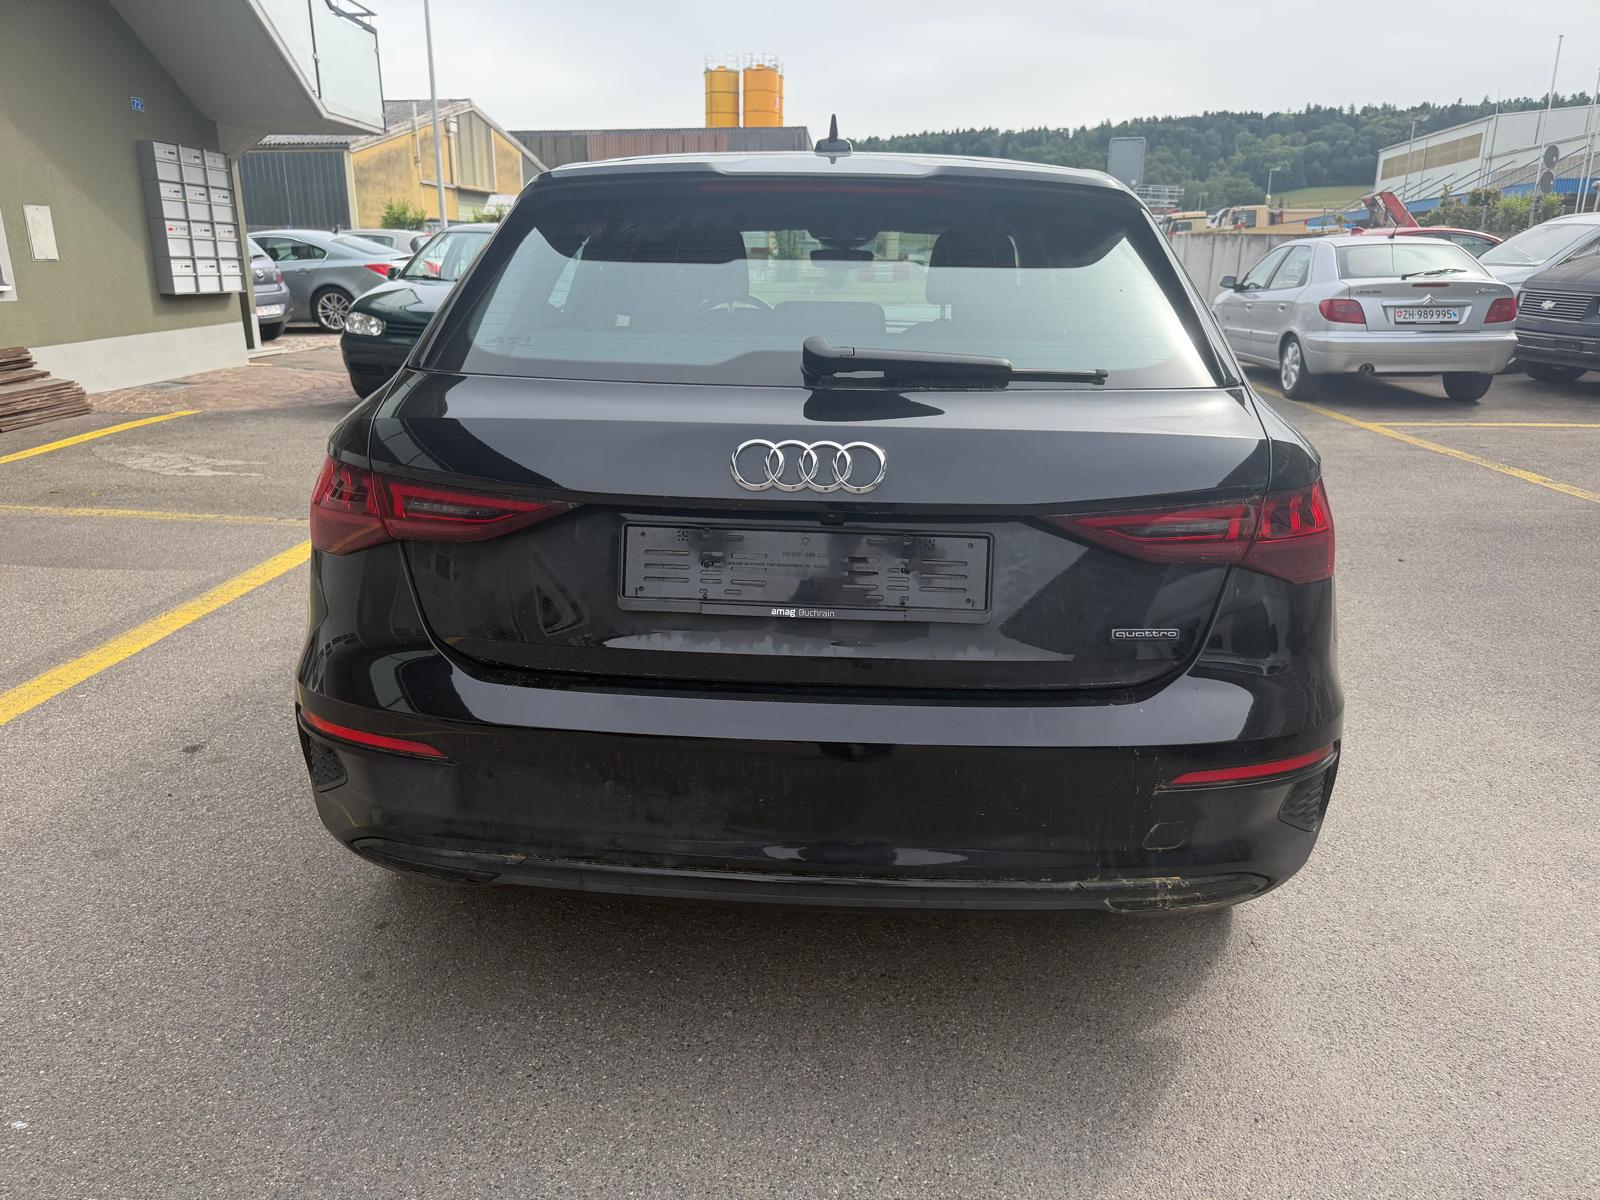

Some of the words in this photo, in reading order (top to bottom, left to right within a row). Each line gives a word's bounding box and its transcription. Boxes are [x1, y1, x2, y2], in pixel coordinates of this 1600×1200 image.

[771, 608, 796, 618] amag
[798, 608, 835, 617] Buchrain
[1115, 630, 1177, 639] quattro
